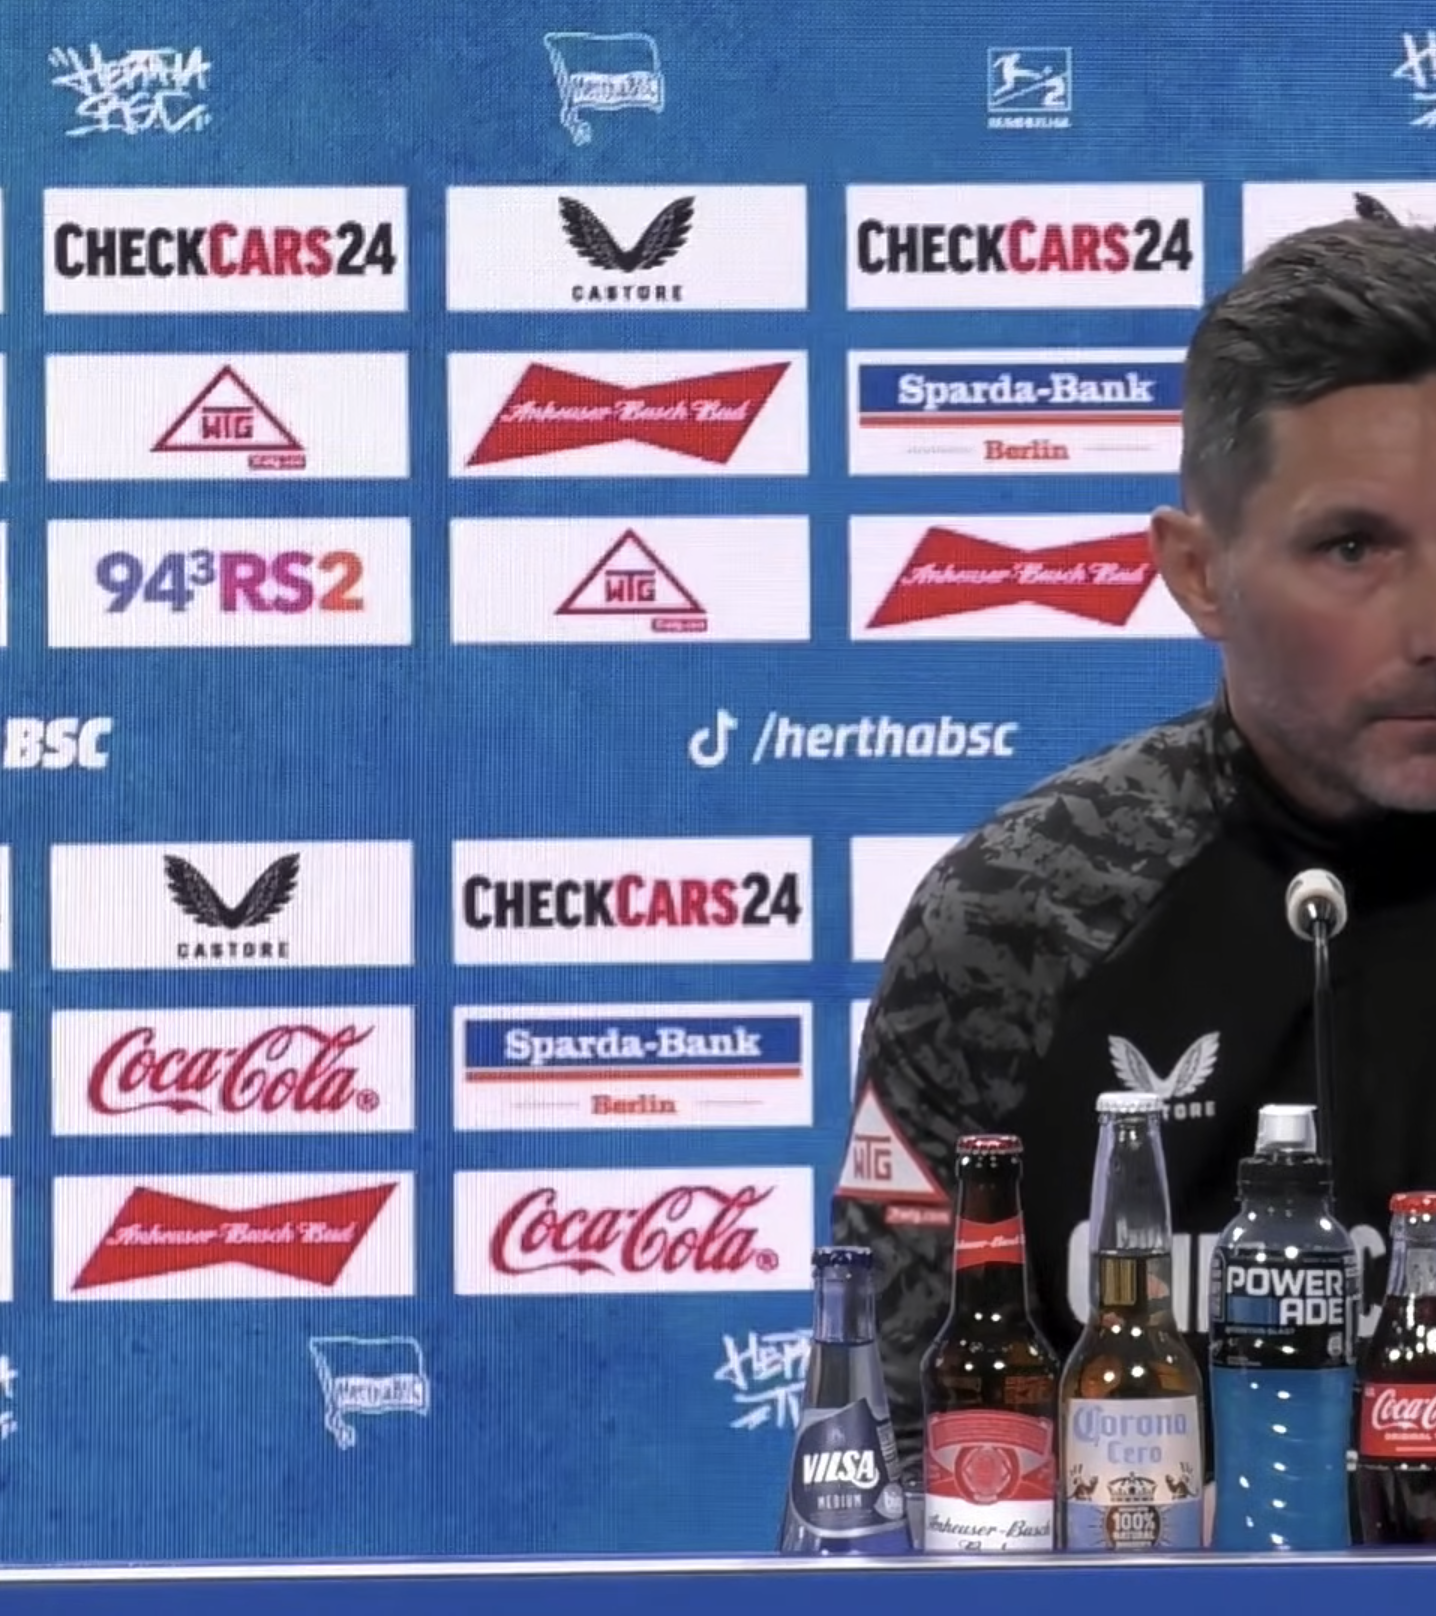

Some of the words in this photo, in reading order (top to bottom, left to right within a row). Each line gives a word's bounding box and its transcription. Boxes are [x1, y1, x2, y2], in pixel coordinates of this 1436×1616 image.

[572, 284, 682, 302] CASTORE
[898, 372, 1154, 411] Sparda-Bank
[984, 439, 1069, 461] Berlin
[3, 717, 112, 769] BSC
[753, 713, 1017, 763] /herthabsc
[177, 941, 287, 959] CASTORE
[505, 1028, 761, 1065] Sparda-Bank
[87, 1024, 379, 1116] Coca-Cola
[591, 1094, 677, 1115] Berlin
[1161, 1100, 1216, 1122] TORE
[853, 1133, 893, 1181] WTG
[489, 1185, 779, 1276] Coca-Cola
[1226, 1265, 1344, 1297] POWER
[1279, 1297, 1345, 1326] ADE
[1073, 1404, 1188, 1446] Corona
[802, 1448, 880, 1490] VILSA
[1107, 1440, 1163, 1466] Cero
[817, 1494, 862, 1510] MEDIUM
[1112, 1512, 1156, 1531] 100%
